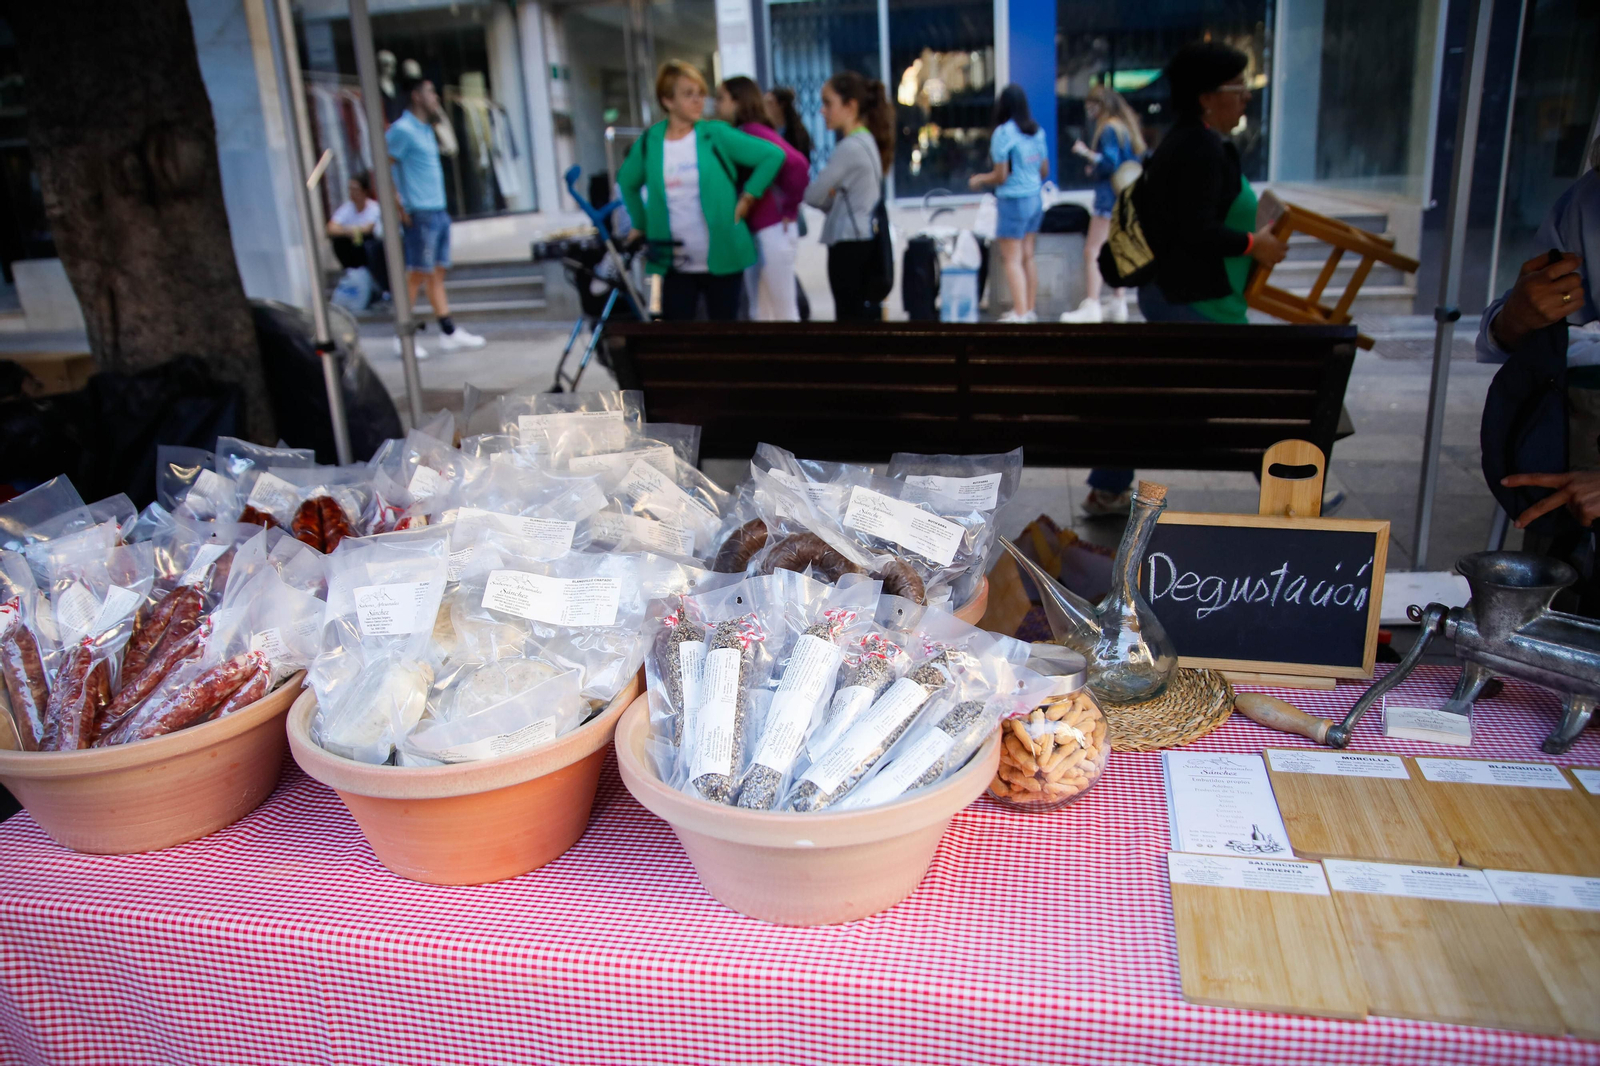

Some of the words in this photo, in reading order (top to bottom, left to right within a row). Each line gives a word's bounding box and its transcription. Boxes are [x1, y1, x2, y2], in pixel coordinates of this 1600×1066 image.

[1148, 552, 1373, 619] Degustación
[1488, 764, 1552, 772] BLANQUILLO
[1411, 869, 1469, 878] LONGANIZA
